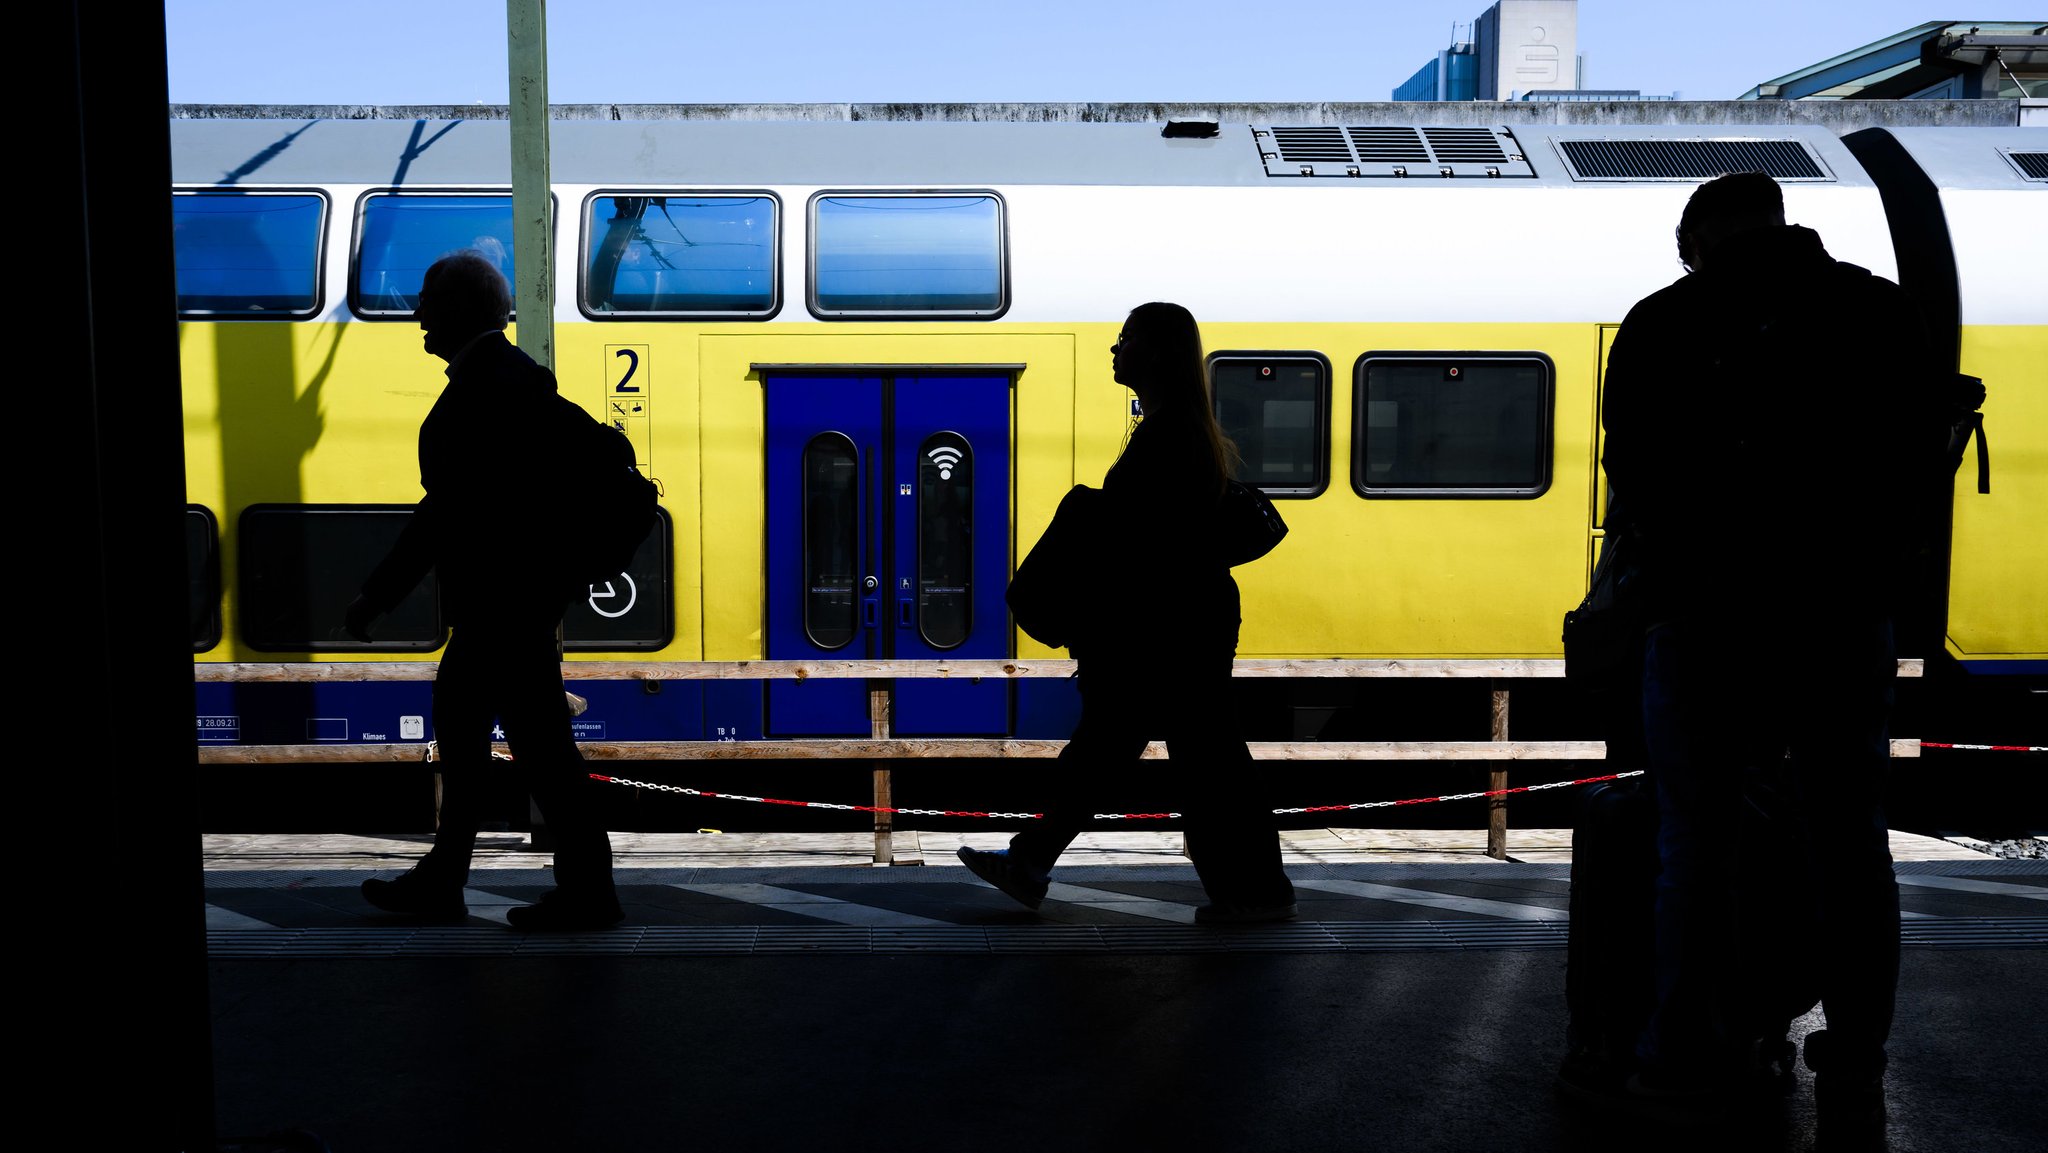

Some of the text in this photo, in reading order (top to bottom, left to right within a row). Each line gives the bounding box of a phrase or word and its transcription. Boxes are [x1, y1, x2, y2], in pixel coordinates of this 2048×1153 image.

[616, 349, 640, 392] 2
[205, 719, 236, 727] 28.09.21
[362, 733, 386, 741] Klimaes
